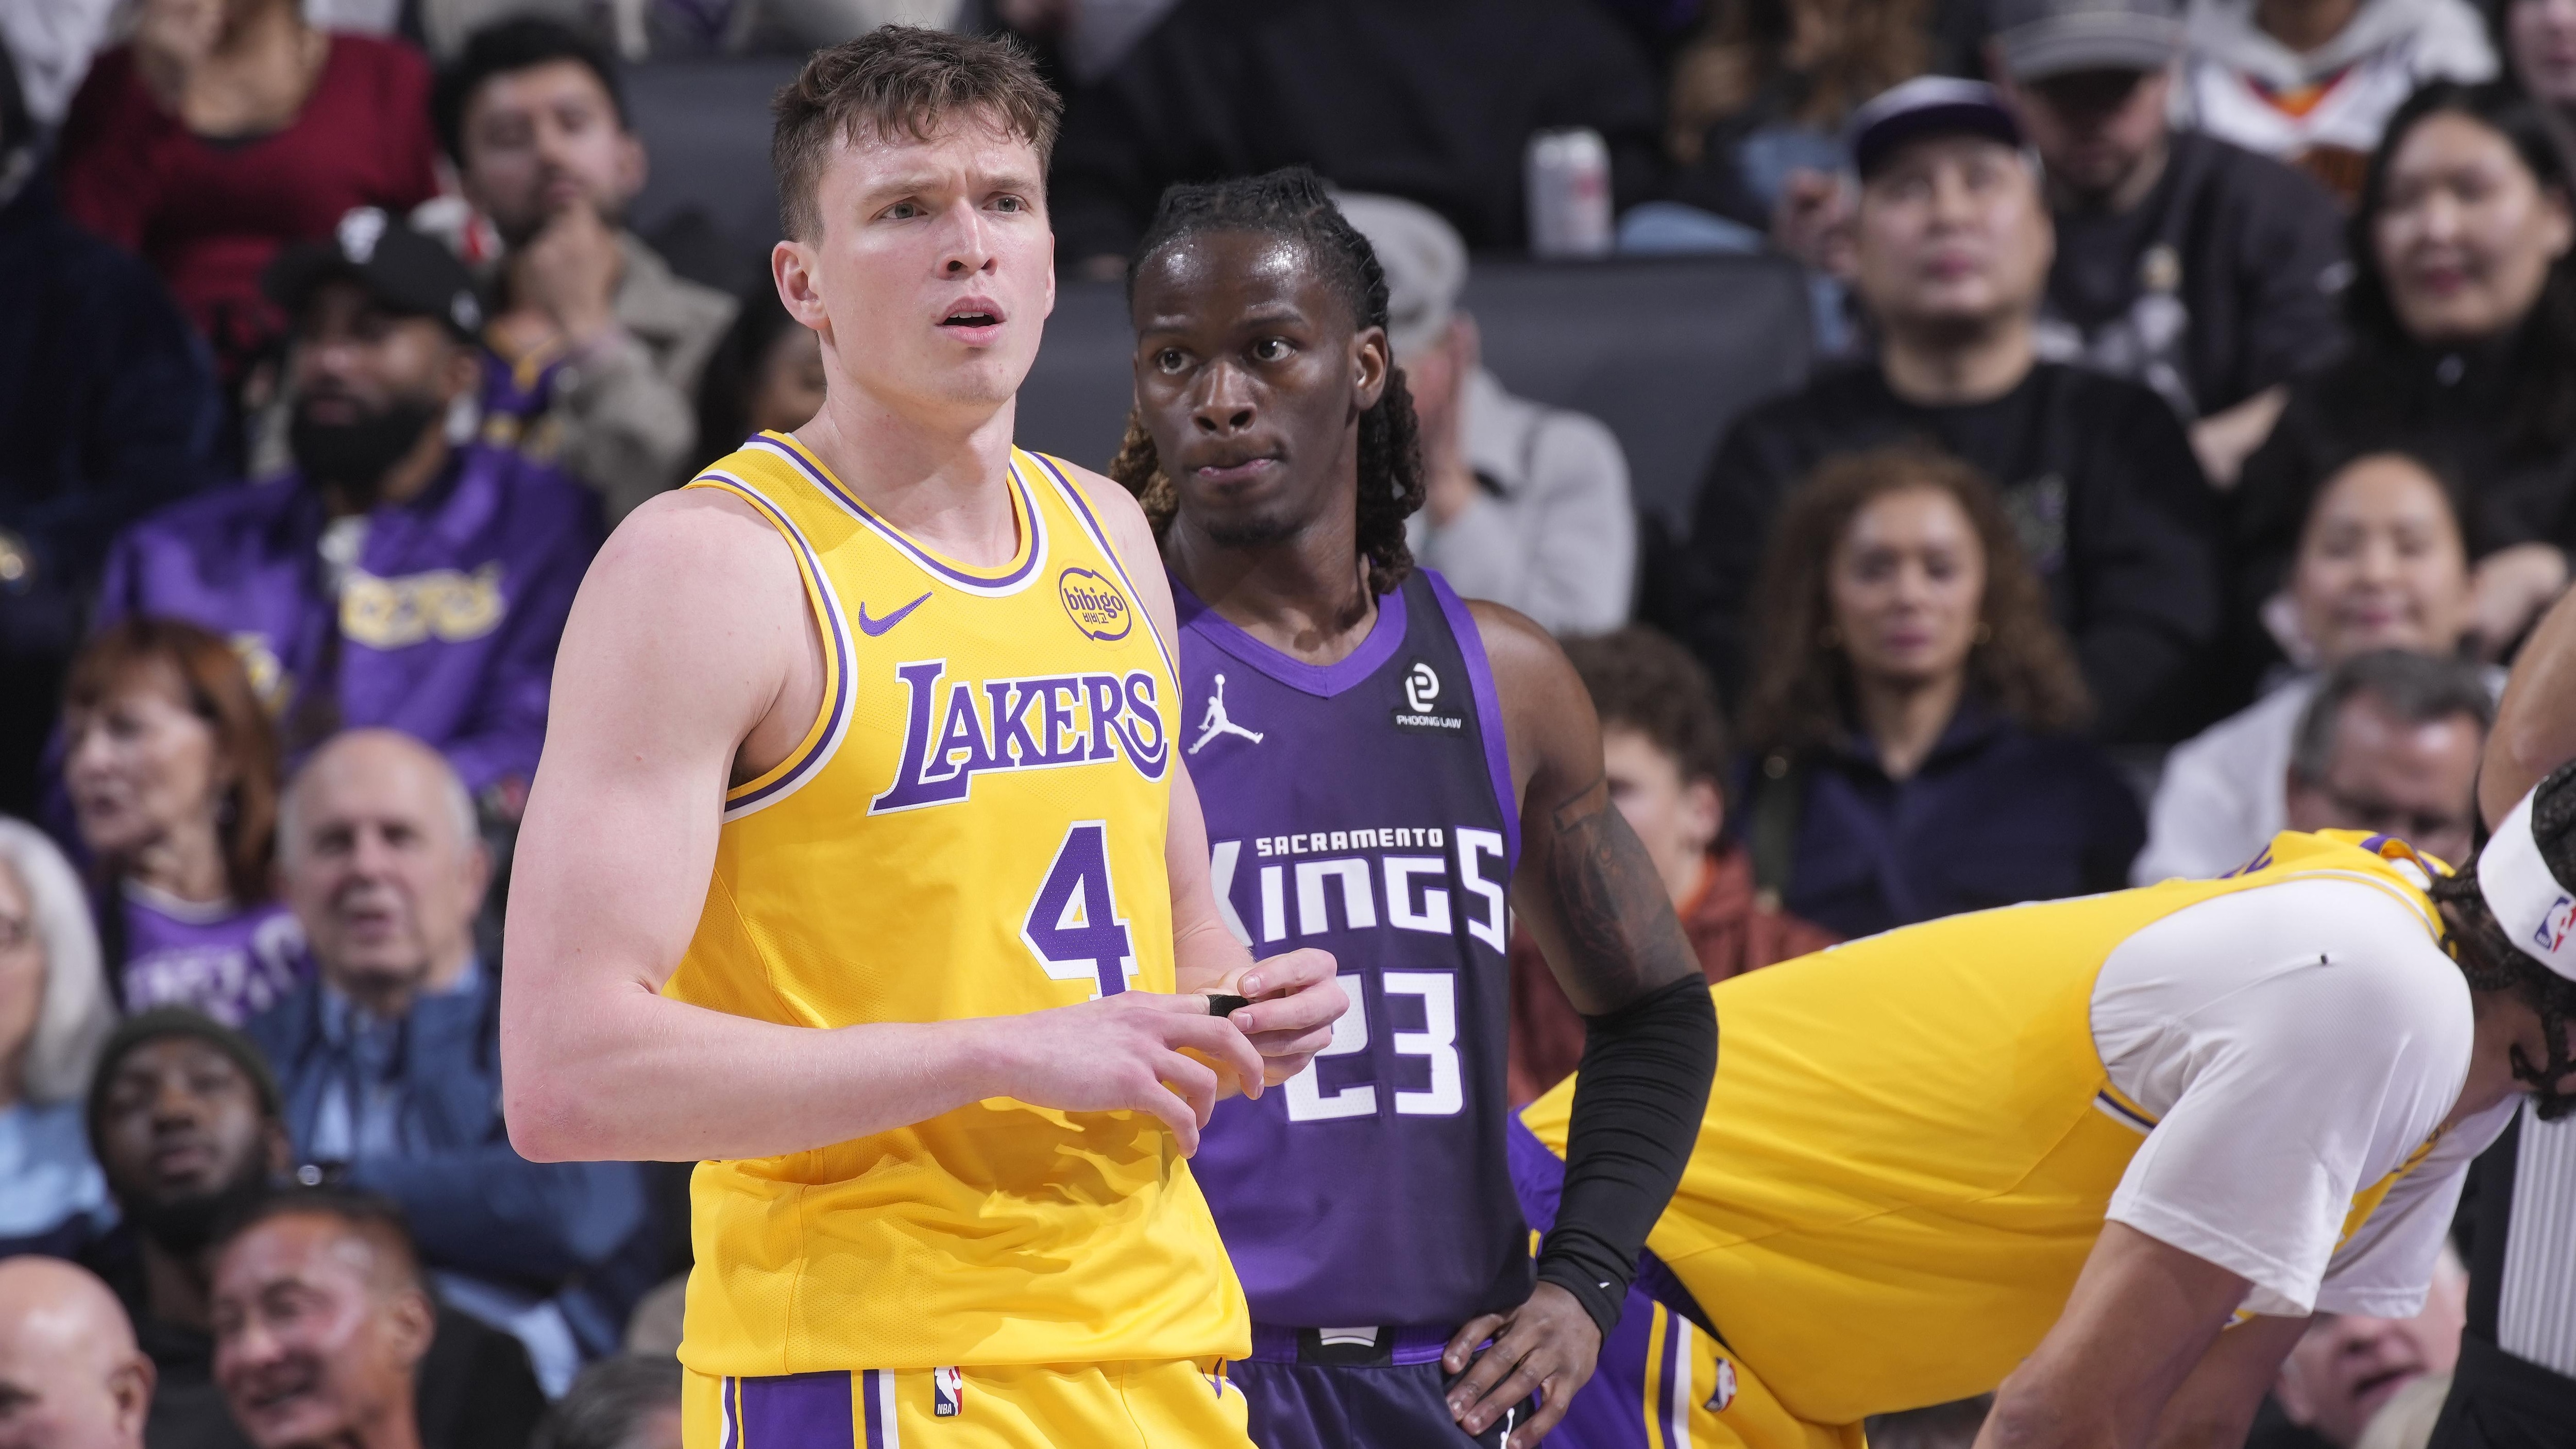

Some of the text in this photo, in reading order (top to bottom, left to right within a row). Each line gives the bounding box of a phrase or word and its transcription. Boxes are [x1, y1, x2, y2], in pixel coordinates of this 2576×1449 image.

[1064, 587, 1124, 619] bibigo
[866, 657, 1168, 817] LAKERS
[1256, 827, 1444, 857] SACRAMENTO
[1019, 819, 1139, 1001] 4
[1284, 971, 1464, 1122] 23
[937, 1403, 952, 1414] NBA
